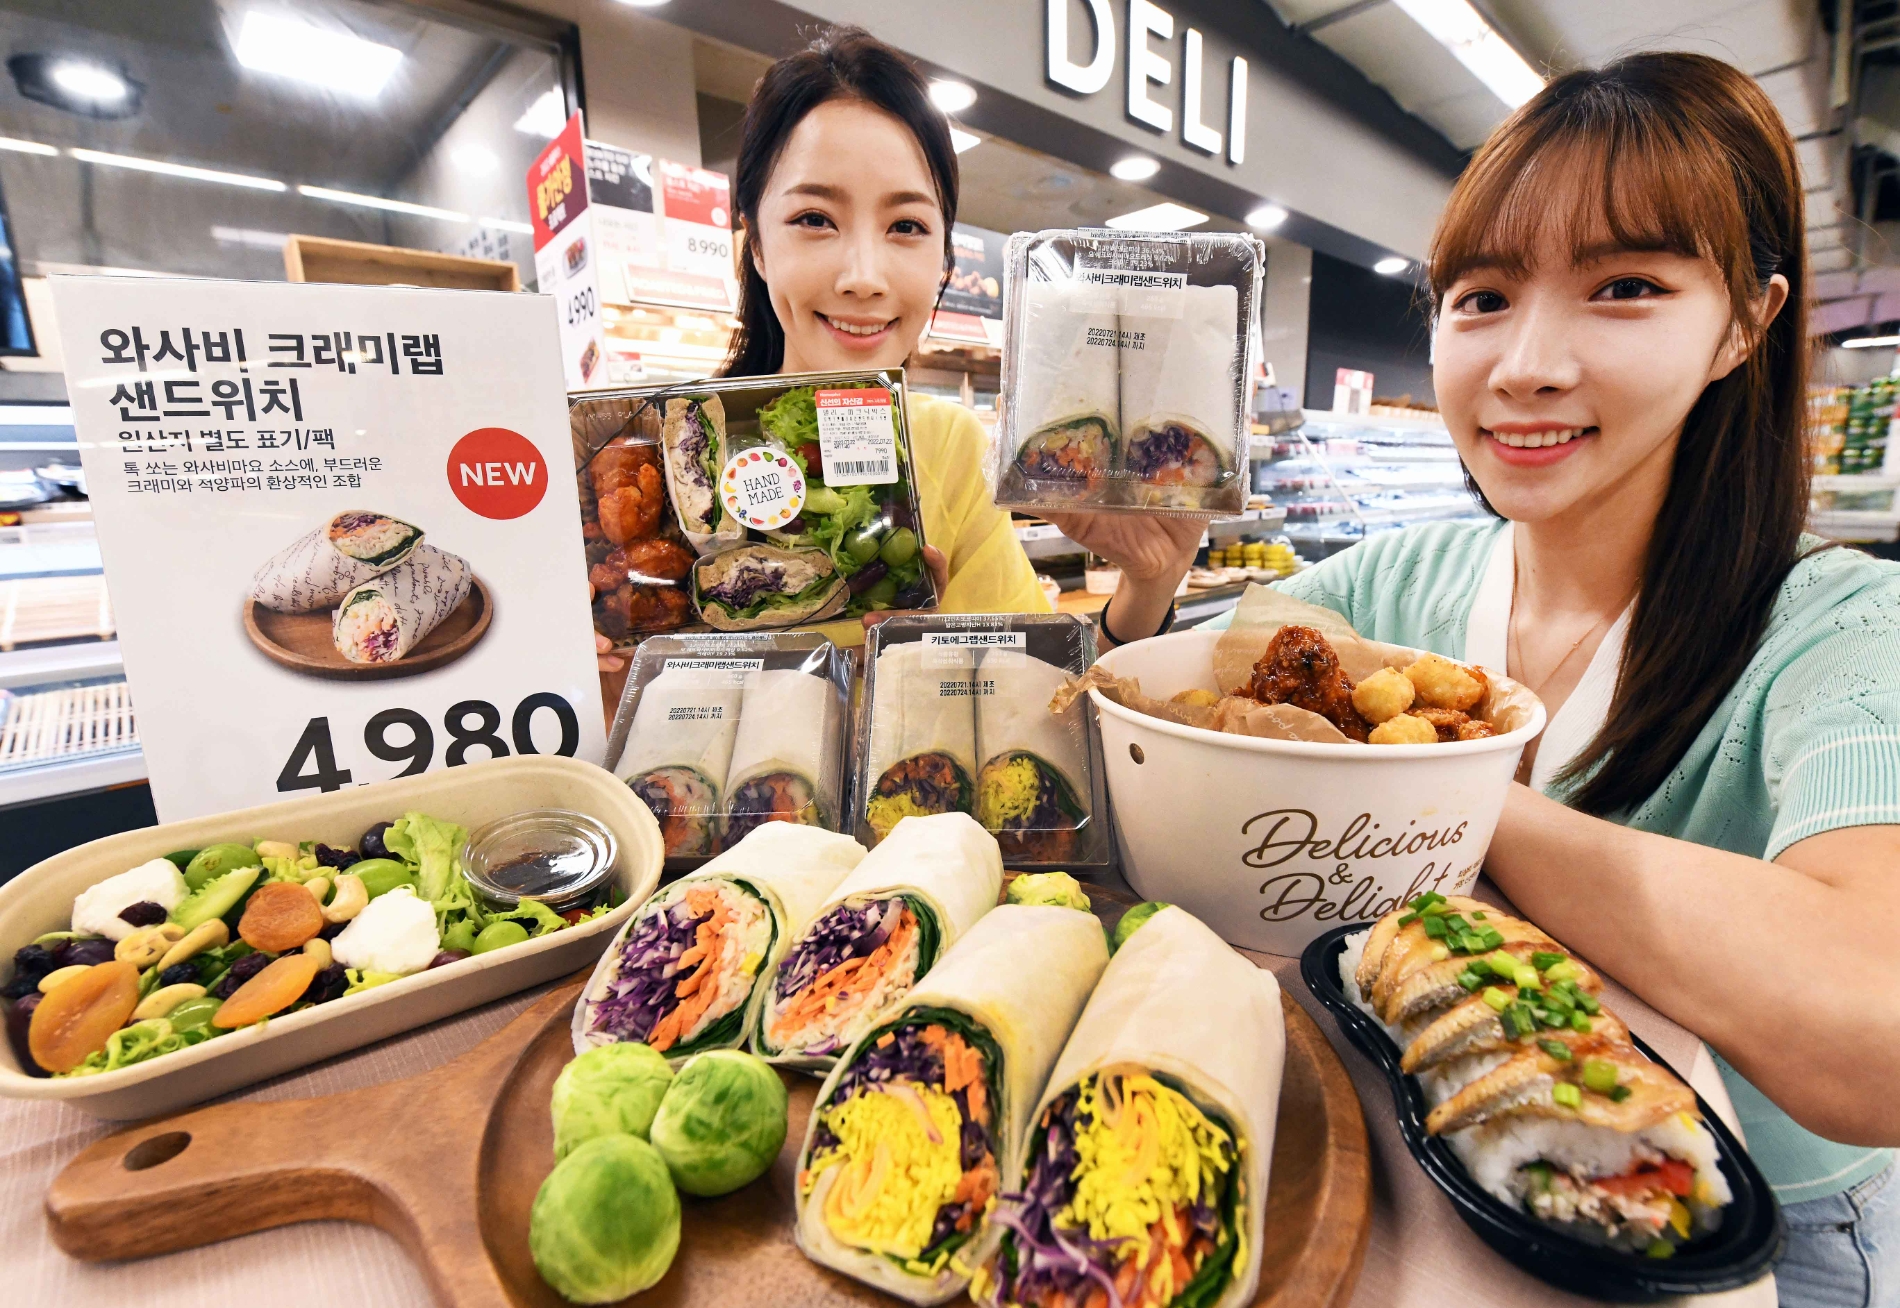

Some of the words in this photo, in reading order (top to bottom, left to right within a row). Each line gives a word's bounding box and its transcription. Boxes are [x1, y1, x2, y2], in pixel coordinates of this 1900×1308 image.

[1045, 0, 1248, 165] DELI
[100, 326, 249, 373] 와사비
[267, 331, 444, 375] 크래미랩
[109, 377, 304, 422] 샌드위치
[820, 398, 841, 407] 신선의
[200, 430, 249, 452] 별도
[257, 428, 335, 451] 표기/팩
[123, 461, 140, 476] 톡
[145, 461, 178, 476] 쏘는
[183, 459, 264, 475] 와사비마요
[269, 458, 318, 473] 소스에,
[323, 457, 383, 472] 부드러운
[459, 461, 536, 487] NEW
[127, 478, 193, 494] 크래미와
[198, 475, 262, 492] 적양파의
[266, 474, 328, 490] 환상적인
[332, 473, 362, 488] 조합
[743, 472, 780, 492] HAND
[748, 486, 784, 506] MADE
[931, 634, 1016, 645] 키토에그랩샌드위치
[666, 661, 760, 670] 와사비크래미랩샌드위치
[276, 691, 580, 793] 4980
[1241, 807, 1469, 869] Delicious
[1329, 862, 1354, 886] &
